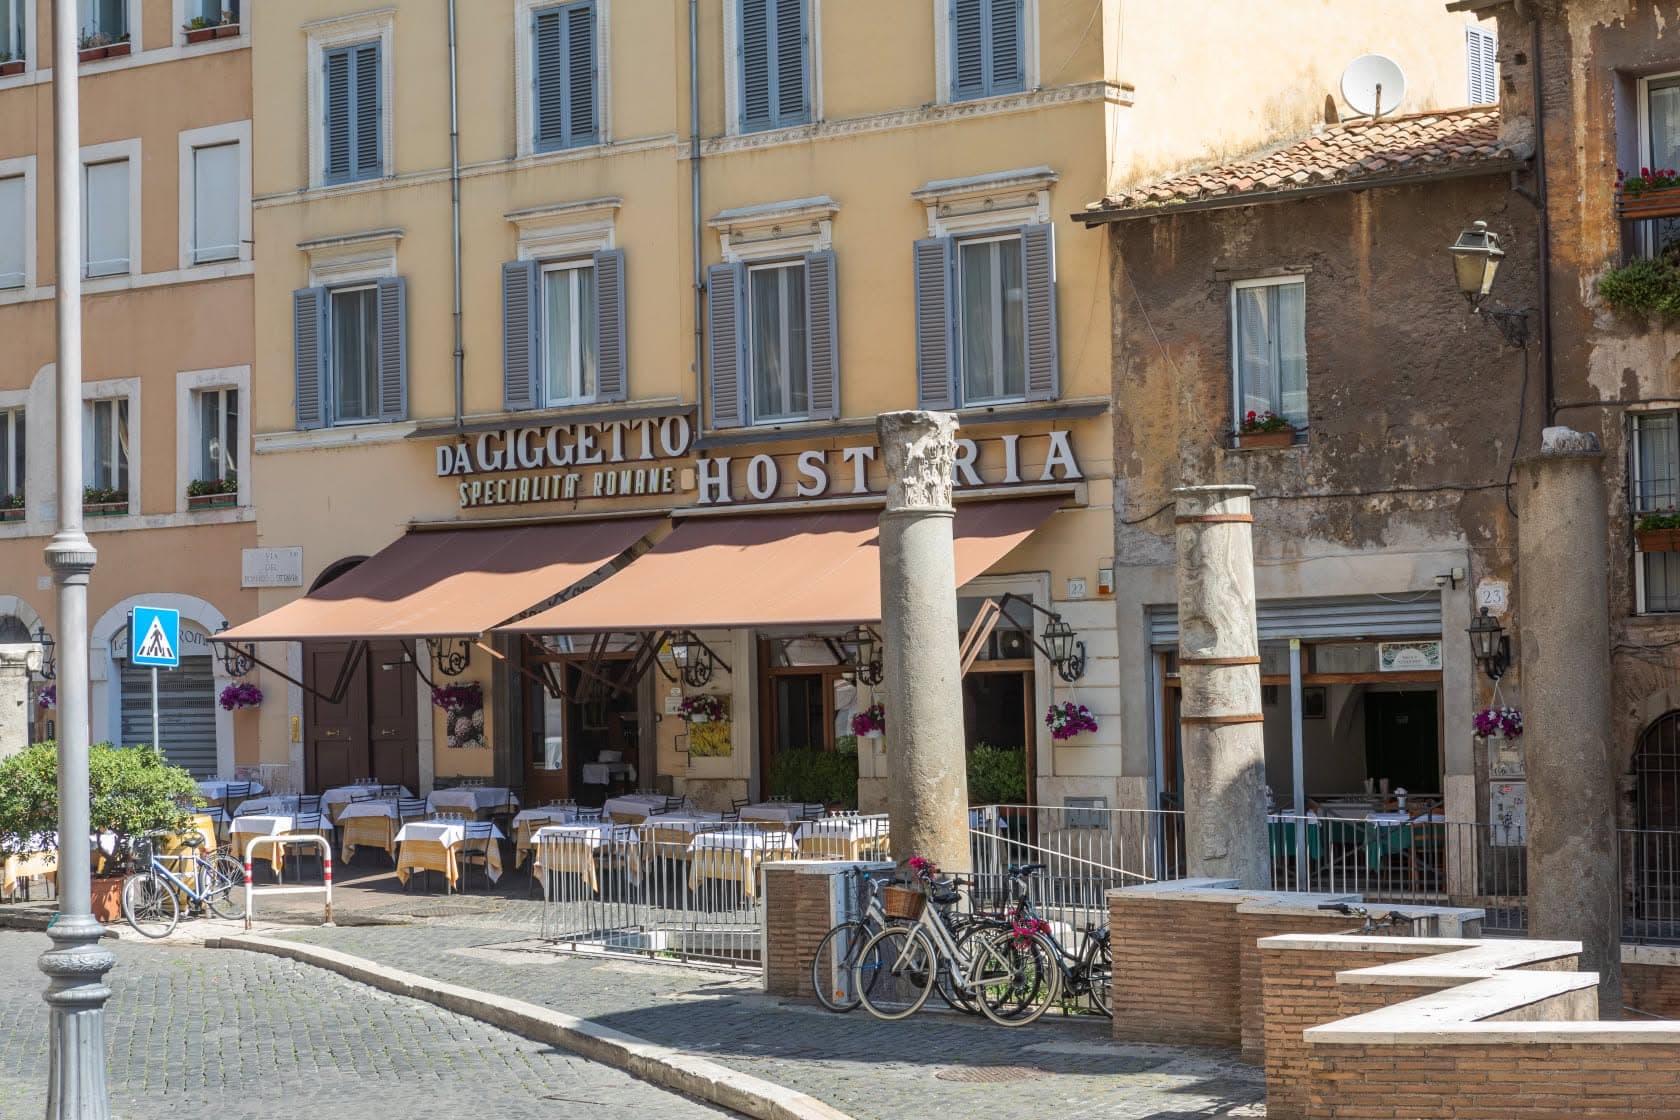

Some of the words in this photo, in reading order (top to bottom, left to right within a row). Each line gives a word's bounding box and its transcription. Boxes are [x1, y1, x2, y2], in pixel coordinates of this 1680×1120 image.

[436, 443, 475, 476] DA
[476, 415, 691, 471] GIGGETTO
[695, 430, 1084, 504] HOSTRIA
[592, 466, 674, 497] ROMANE
[1481, 590, 1502, 604] 23
